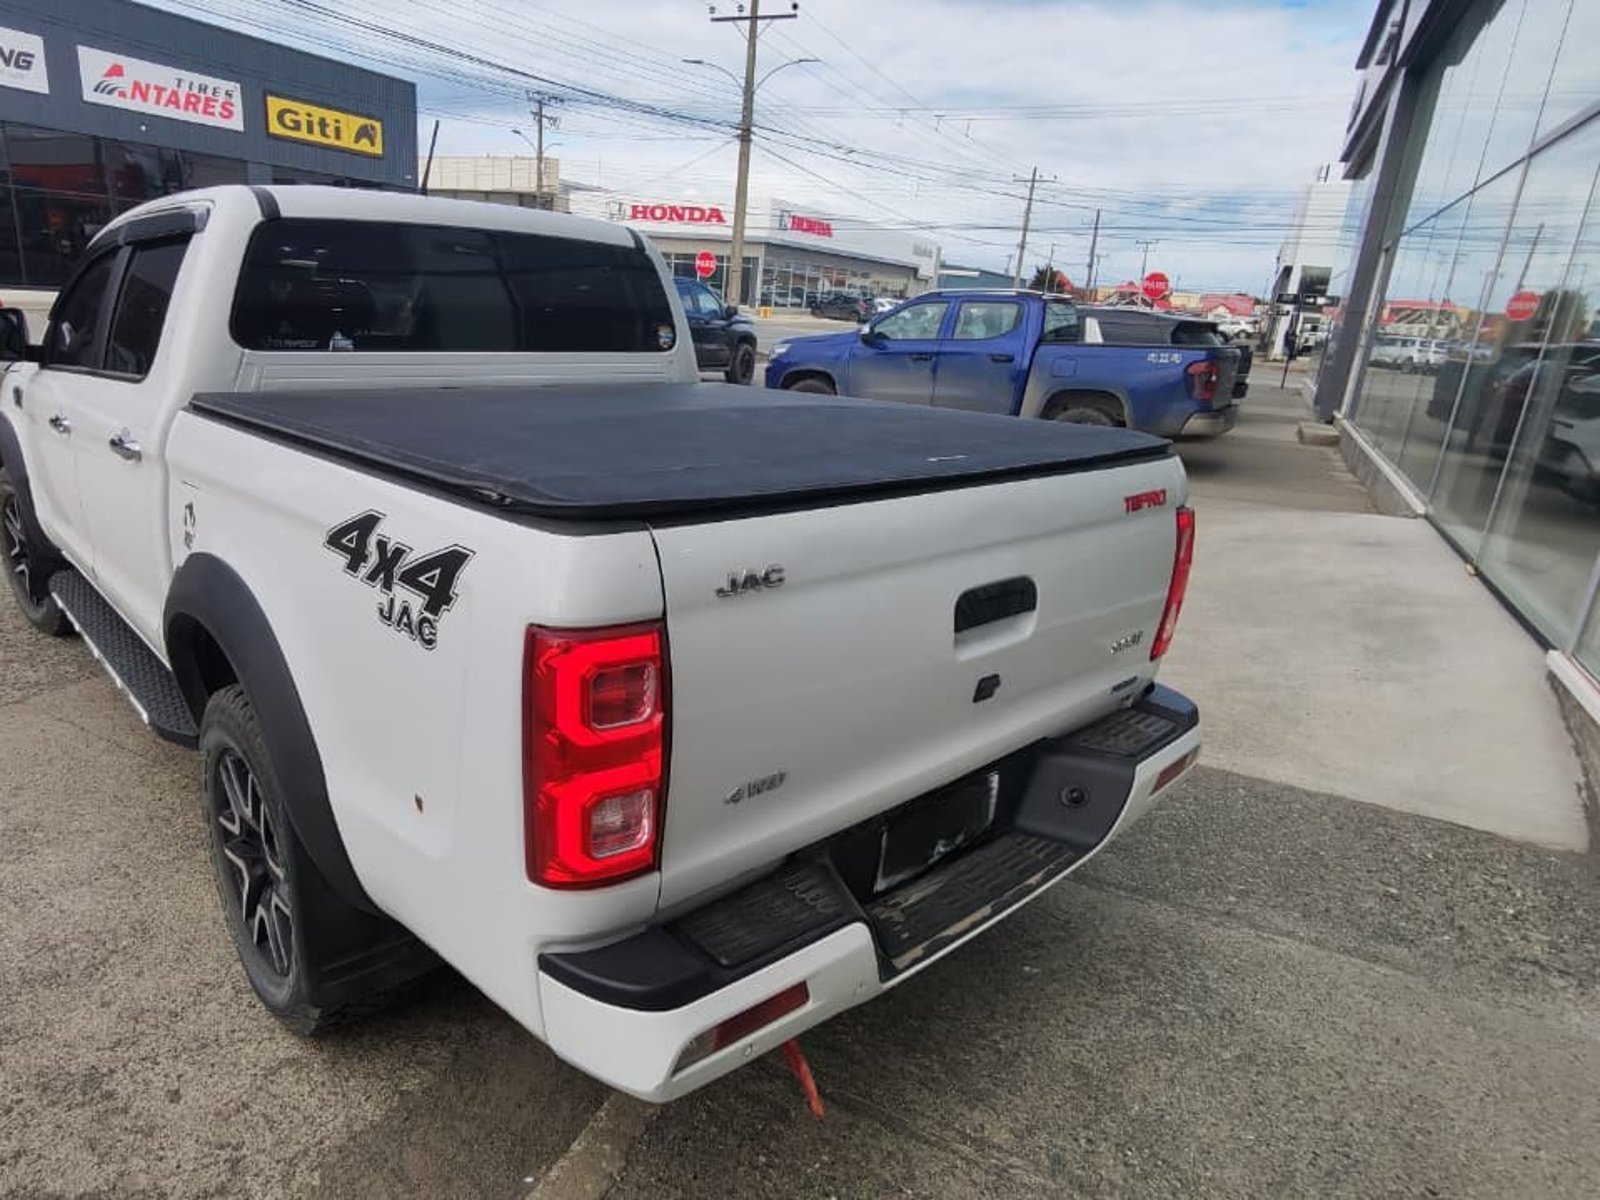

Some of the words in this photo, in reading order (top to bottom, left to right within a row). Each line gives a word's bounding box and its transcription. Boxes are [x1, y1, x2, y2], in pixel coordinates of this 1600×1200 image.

[174, 77, 235, 100] TIRES
[276, 107, 342, 141] Giti
[631, 205, 725, 223] HONDA
[715, 565, 786, 599] JAC
[376, 595, 438, 650] JAC
